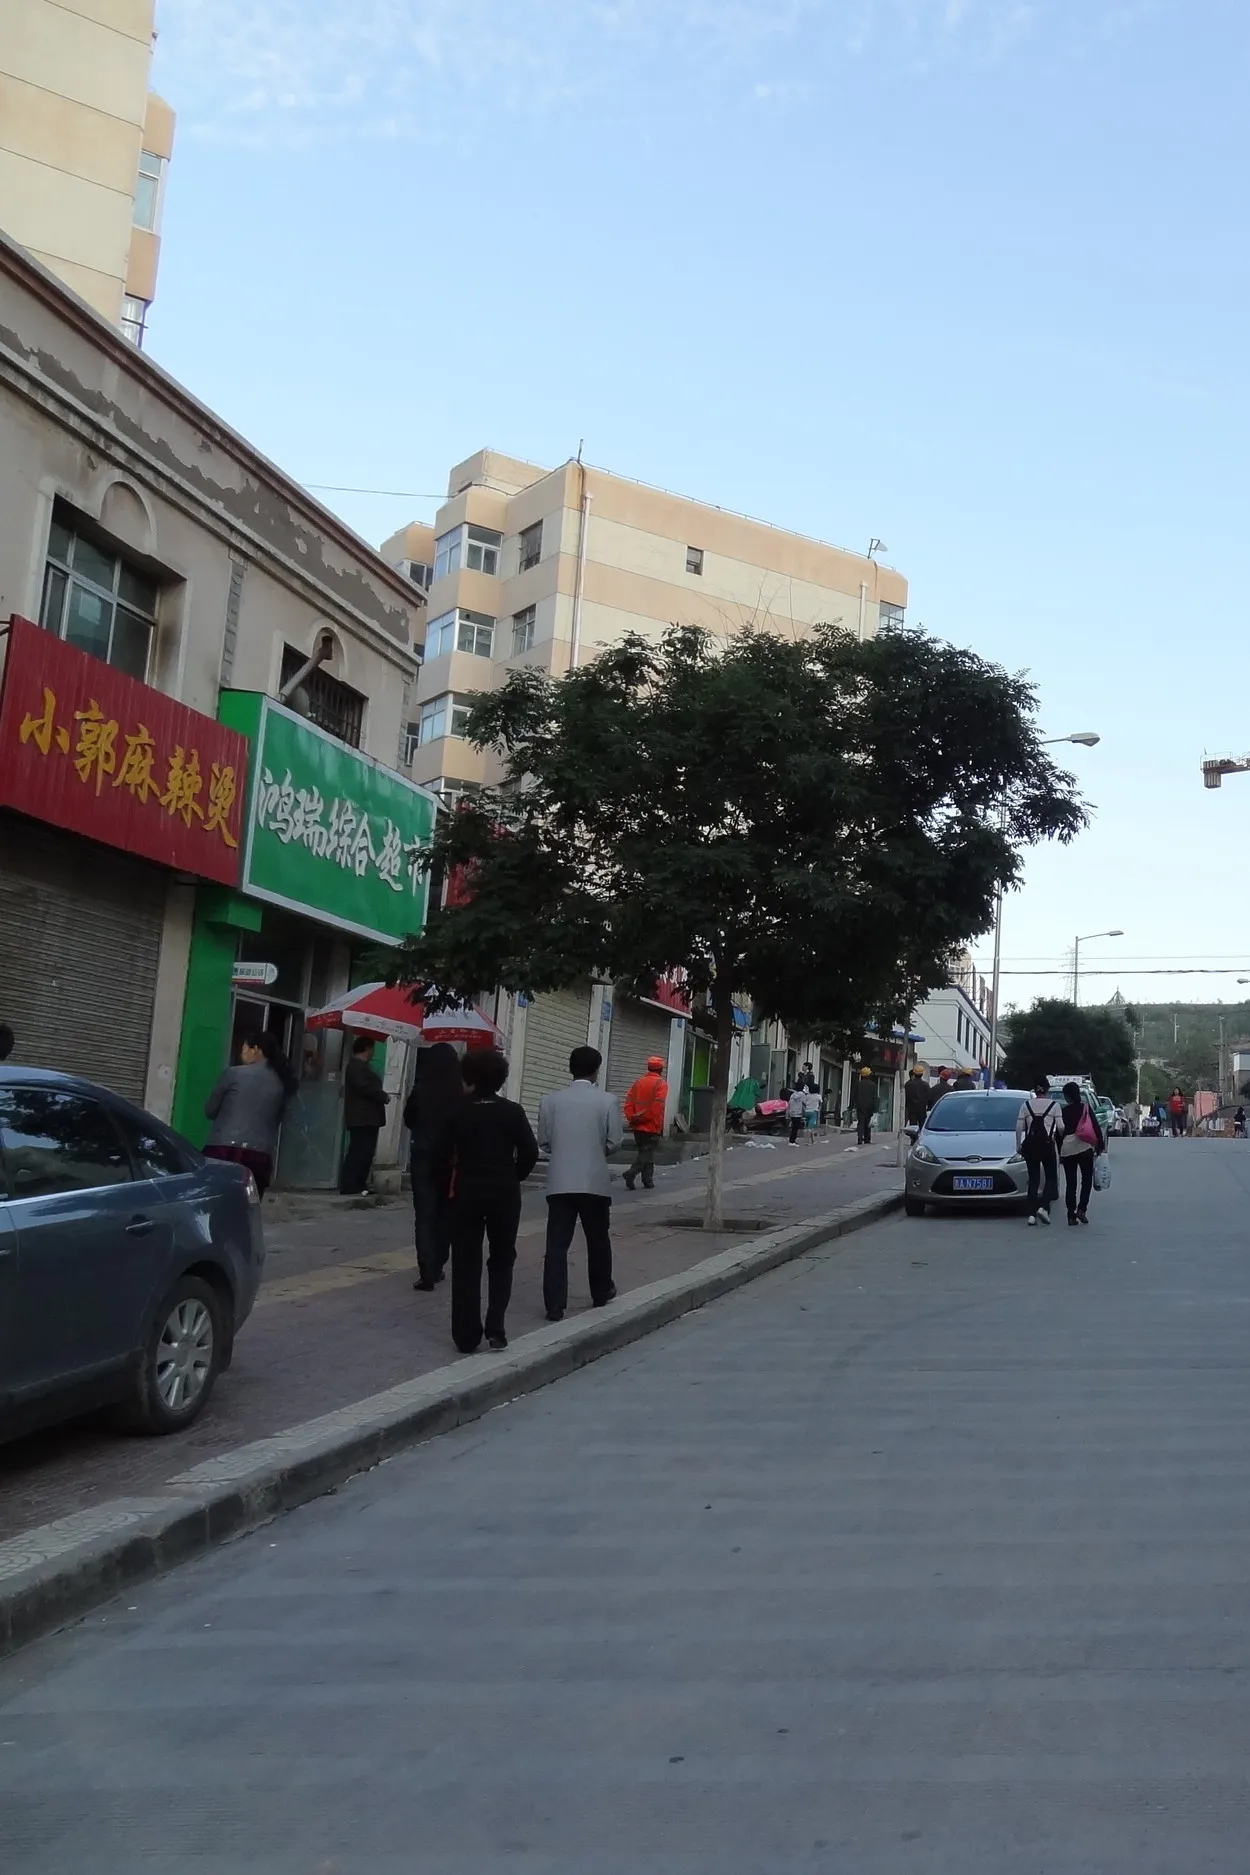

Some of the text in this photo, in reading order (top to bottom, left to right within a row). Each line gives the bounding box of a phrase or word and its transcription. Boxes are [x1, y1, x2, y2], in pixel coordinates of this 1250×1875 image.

[19, 687, 238, 848] 小郭麻辣烫
